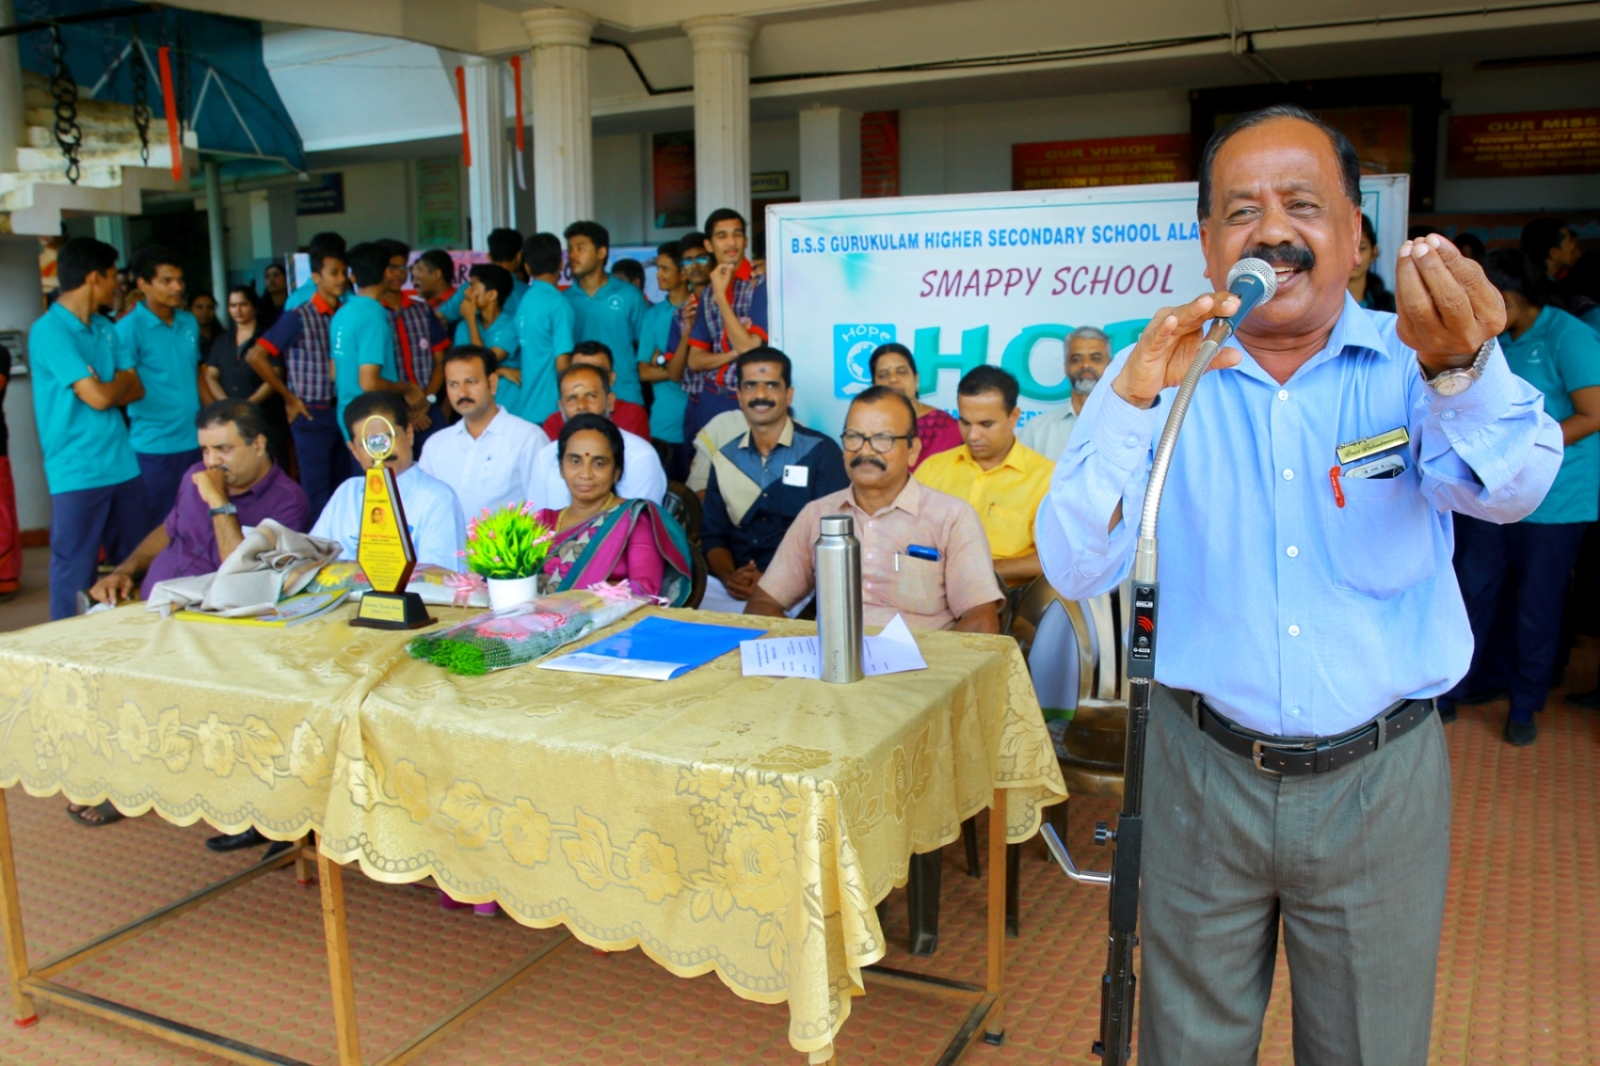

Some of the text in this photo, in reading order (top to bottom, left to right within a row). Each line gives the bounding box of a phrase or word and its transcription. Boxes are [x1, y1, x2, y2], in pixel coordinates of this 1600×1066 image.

[1488, 121, 1535, 132] OUR
[1090, 144, 1156, 156] VISION
[791, 237, 826, 253] B.S.S
[831, 232, 919, 252] GURUKULAM
[925, 229, 983, 249] HIGHER
[988, 226, 1086, 247] SECONDARY
[1091, 223, 1161, 244] SCHOOL
[920, 264, 1173, 298] SMAPPY SCHOOL
